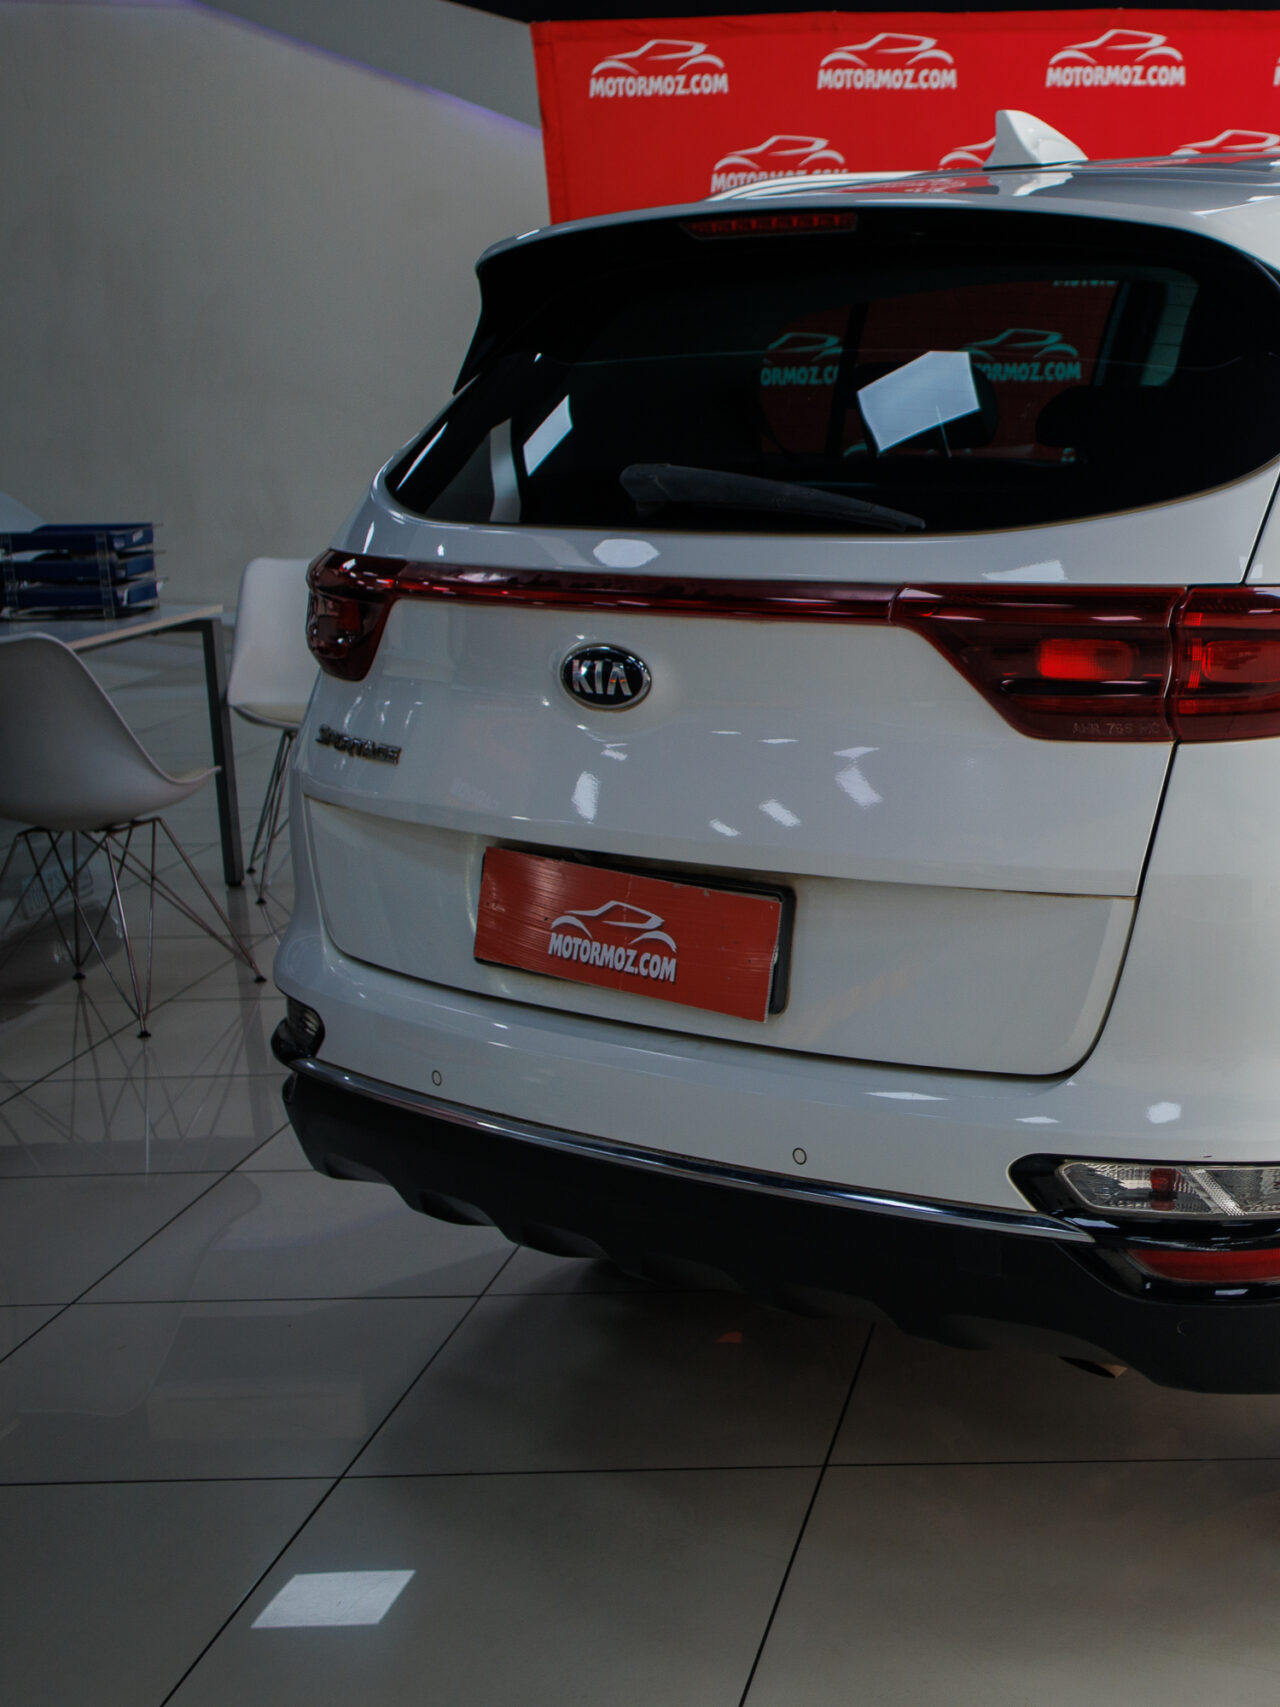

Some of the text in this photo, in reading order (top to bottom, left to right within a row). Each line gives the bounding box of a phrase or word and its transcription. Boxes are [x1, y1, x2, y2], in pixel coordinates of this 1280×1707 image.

[589, 74, 729, 98] MOTORMOZ.COM
[817, 66, 957, 90] MOTORMOZ.COM
[1045, 64, 1186, 88] MOTORMOZ.COM
[572, 659, 632, 696] KIA
[548, 932, 676, 983] MOTORMOZ.COM
